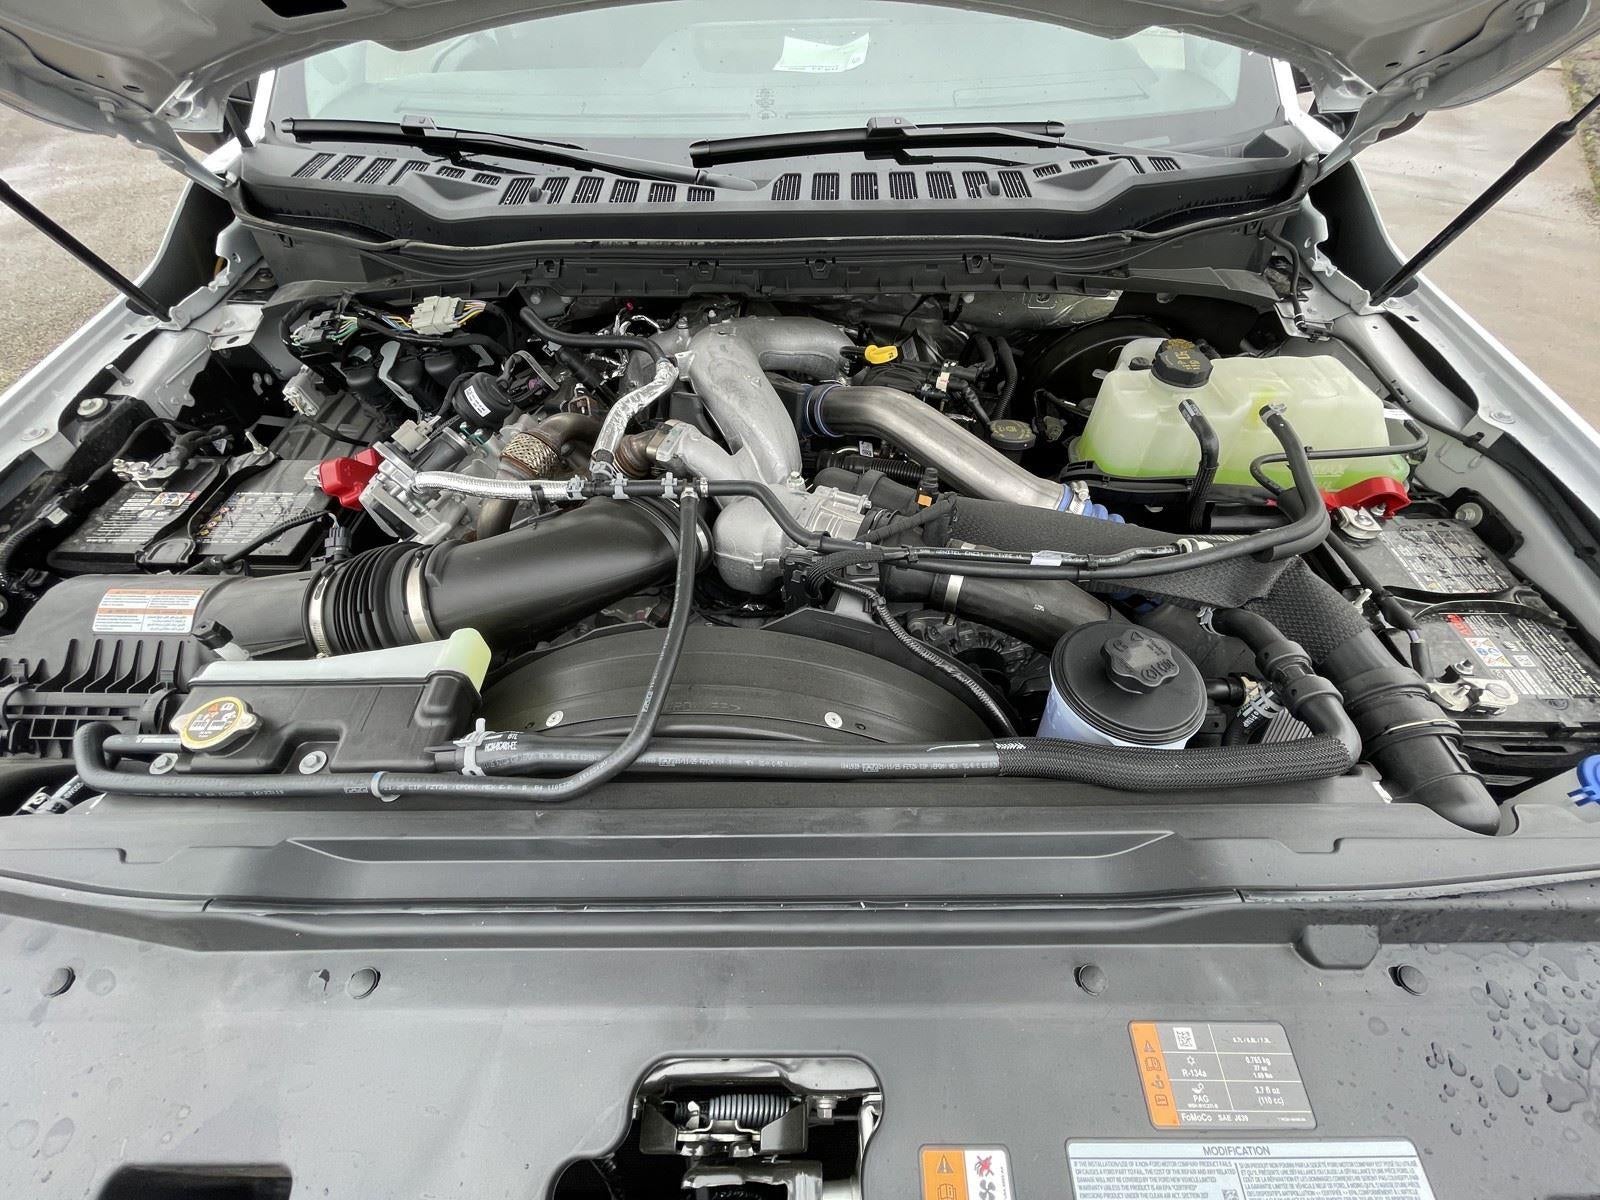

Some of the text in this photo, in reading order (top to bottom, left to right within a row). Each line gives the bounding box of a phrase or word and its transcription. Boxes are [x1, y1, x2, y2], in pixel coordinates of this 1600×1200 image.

[1262, 1056, 1271, 1066] kg
[1182, 1068, 1207, 1078] R-134a
[1193, 1095, 1209, 1103] PAG
[1257, 1096, 1285, 1106] (110 cc)
[1181, 1112, 1212, 1121] FoMoCo
[1202, 1146, 1271, 1156] MODIFICATION
